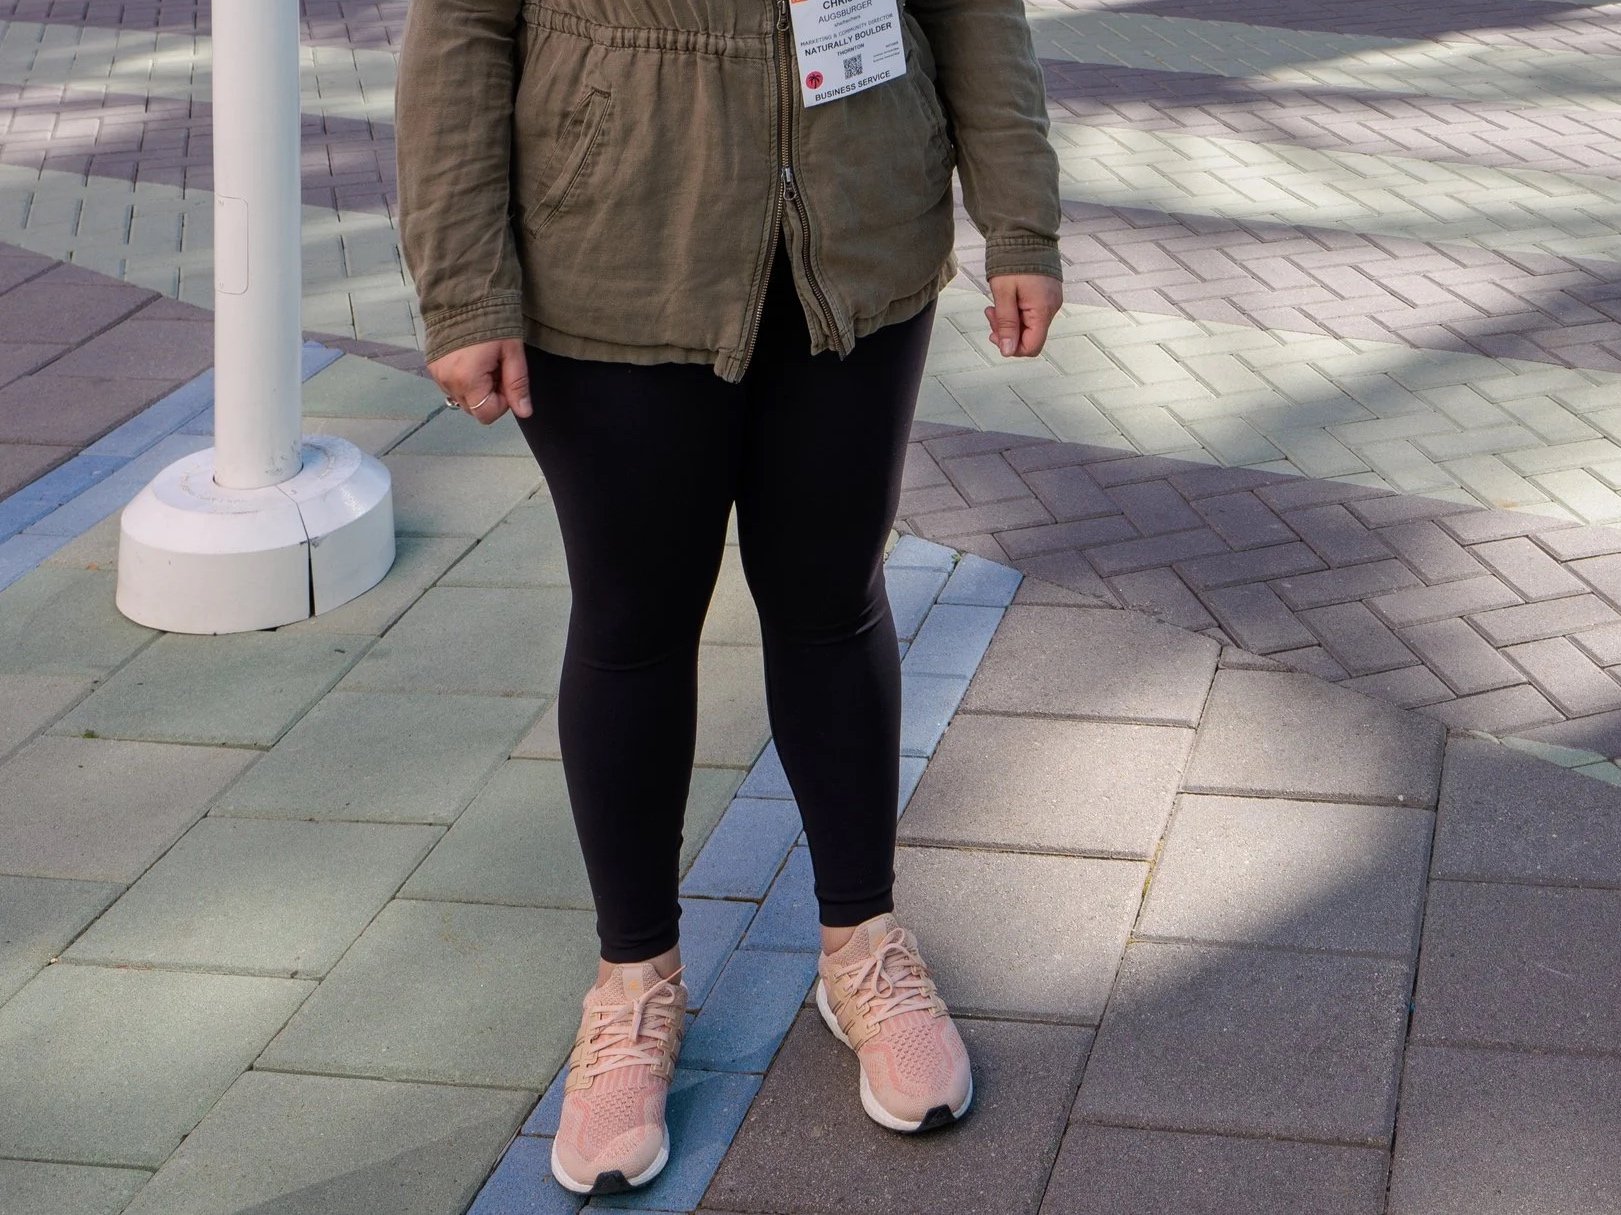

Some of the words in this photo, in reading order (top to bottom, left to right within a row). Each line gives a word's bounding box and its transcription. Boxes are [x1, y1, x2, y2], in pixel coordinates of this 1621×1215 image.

[818, 0, 873, 24] AUGSBURGER
[800, 34, 833, 47] MARKETING
[838, 23, 867, 37] COMMUNITY
[868, 13, 894, 26] DIRECTOR
[804, 36, 854, 57] NATURALLY
[854, 21, 892, 41] BOULDER
[837, 43, 865, 56] THORNTON
[815, 83, 857, 102] BUSINESS
[857, 69, 891, 88] SERVICE
